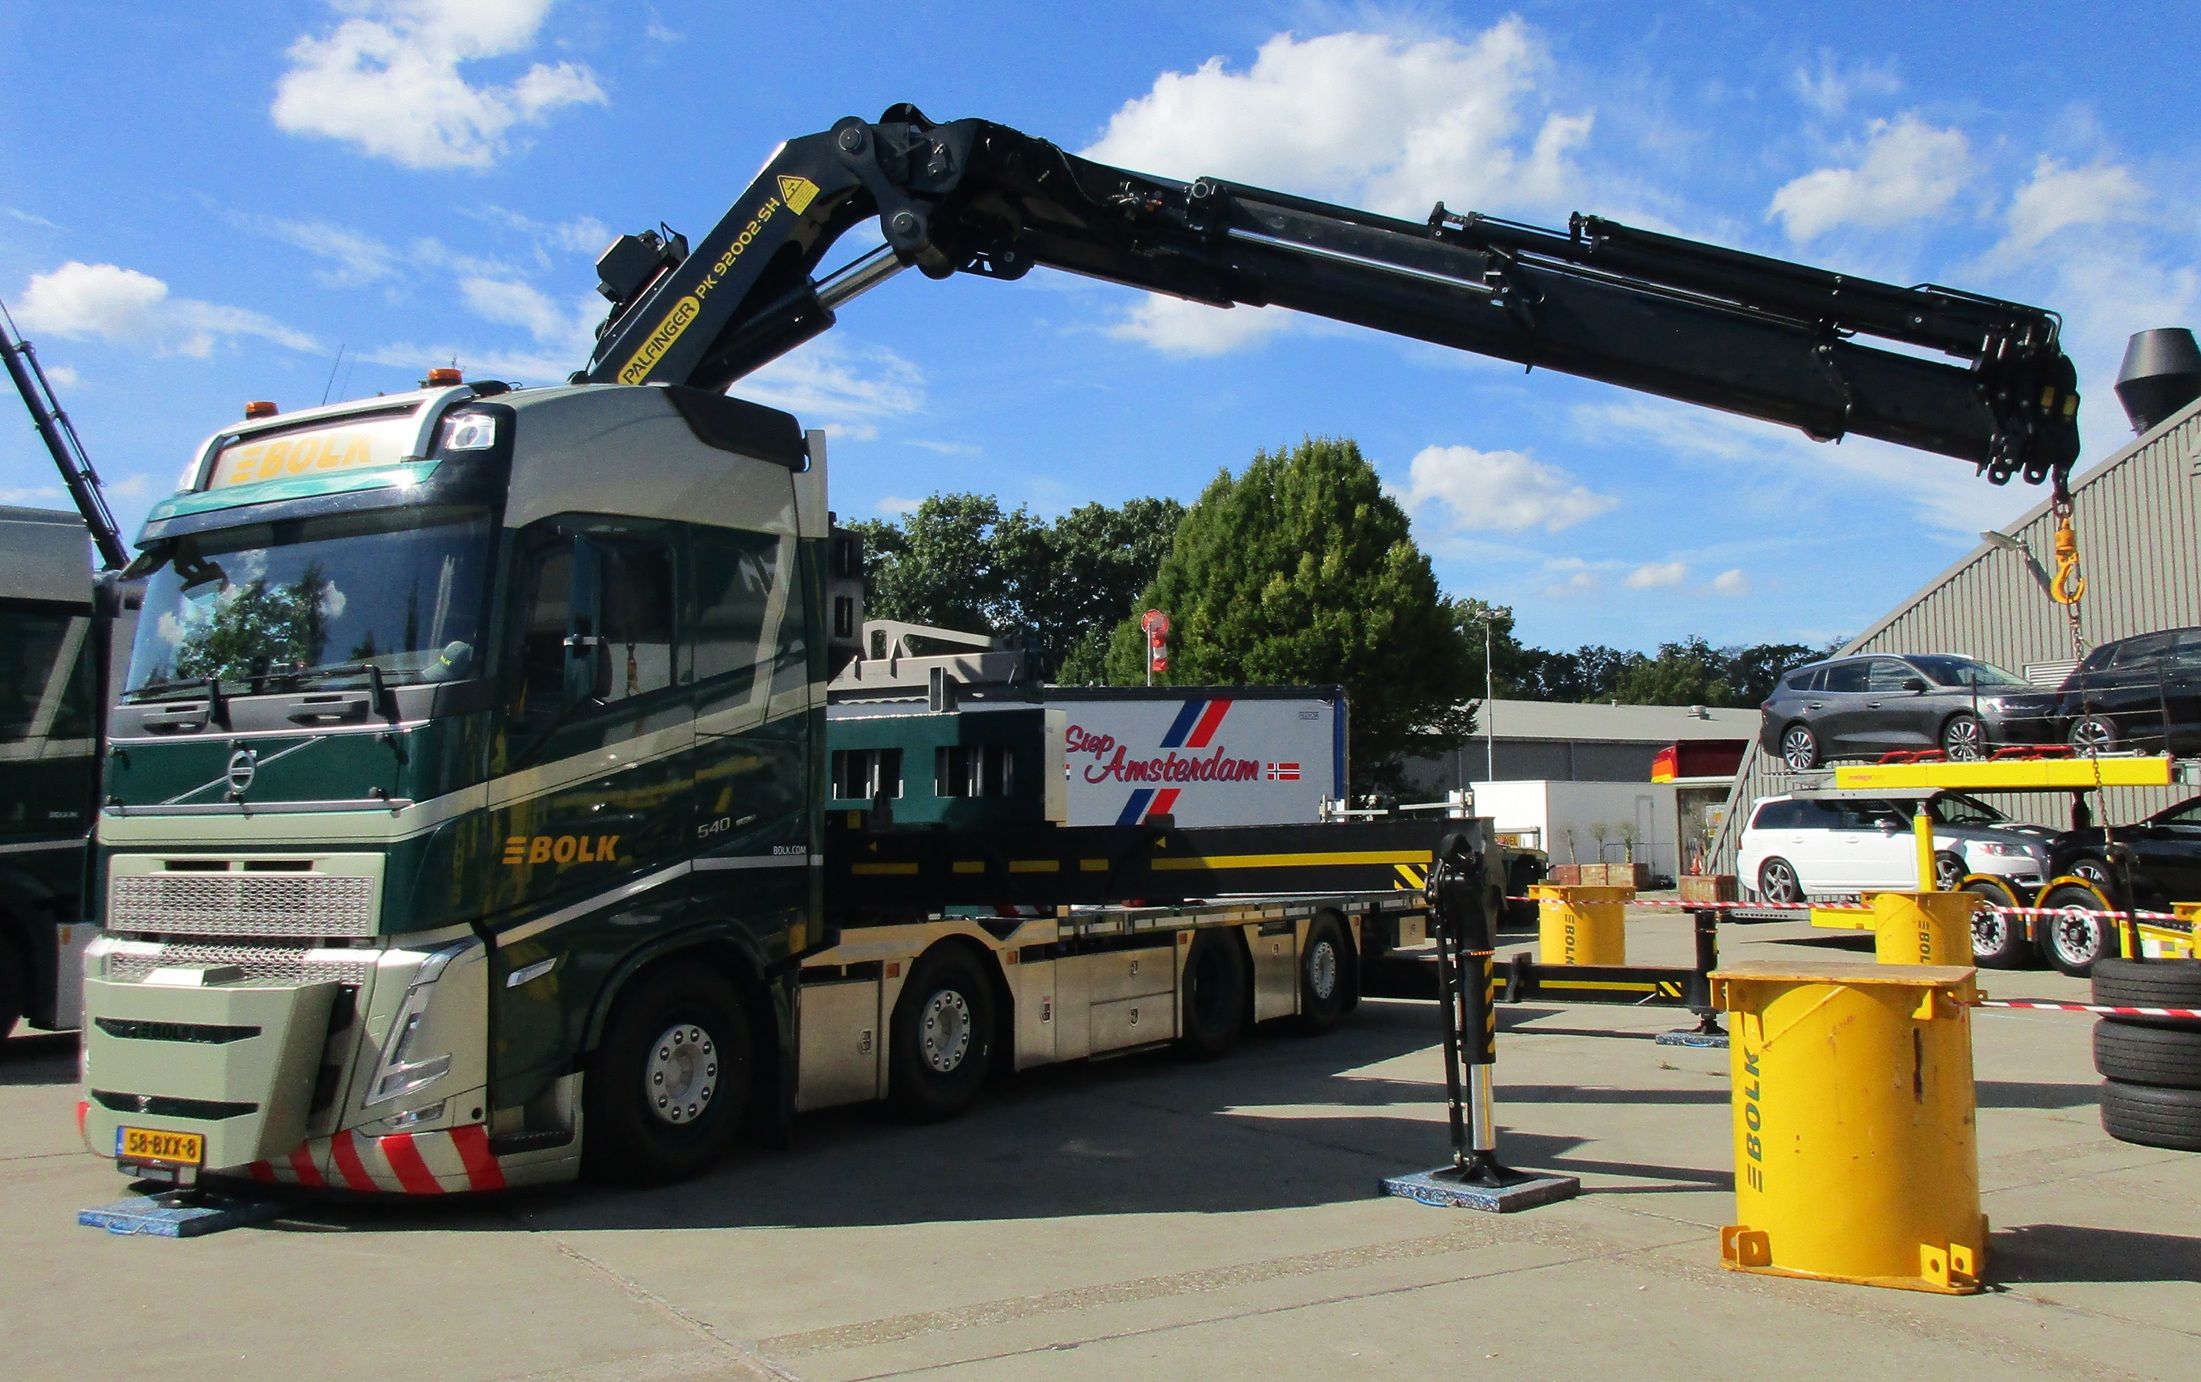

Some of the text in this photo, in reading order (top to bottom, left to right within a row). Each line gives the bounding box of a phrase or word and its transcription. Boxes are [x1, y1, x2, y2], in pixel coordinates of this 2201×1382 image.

[622, 301, 696, 385] PALFINGER
[694, 273, 718, 299] PK
[1065, 724, 1115, 760] Siep
[1084, 745, 1260, 785] Amsterdam
[697, 816, 731, 838] 540
[773, 844, 807, 855] BOLK.COM
[1919, 931, 1931, 963] BOL
[129, 1132, 197, 1159] 58-BXX-8
